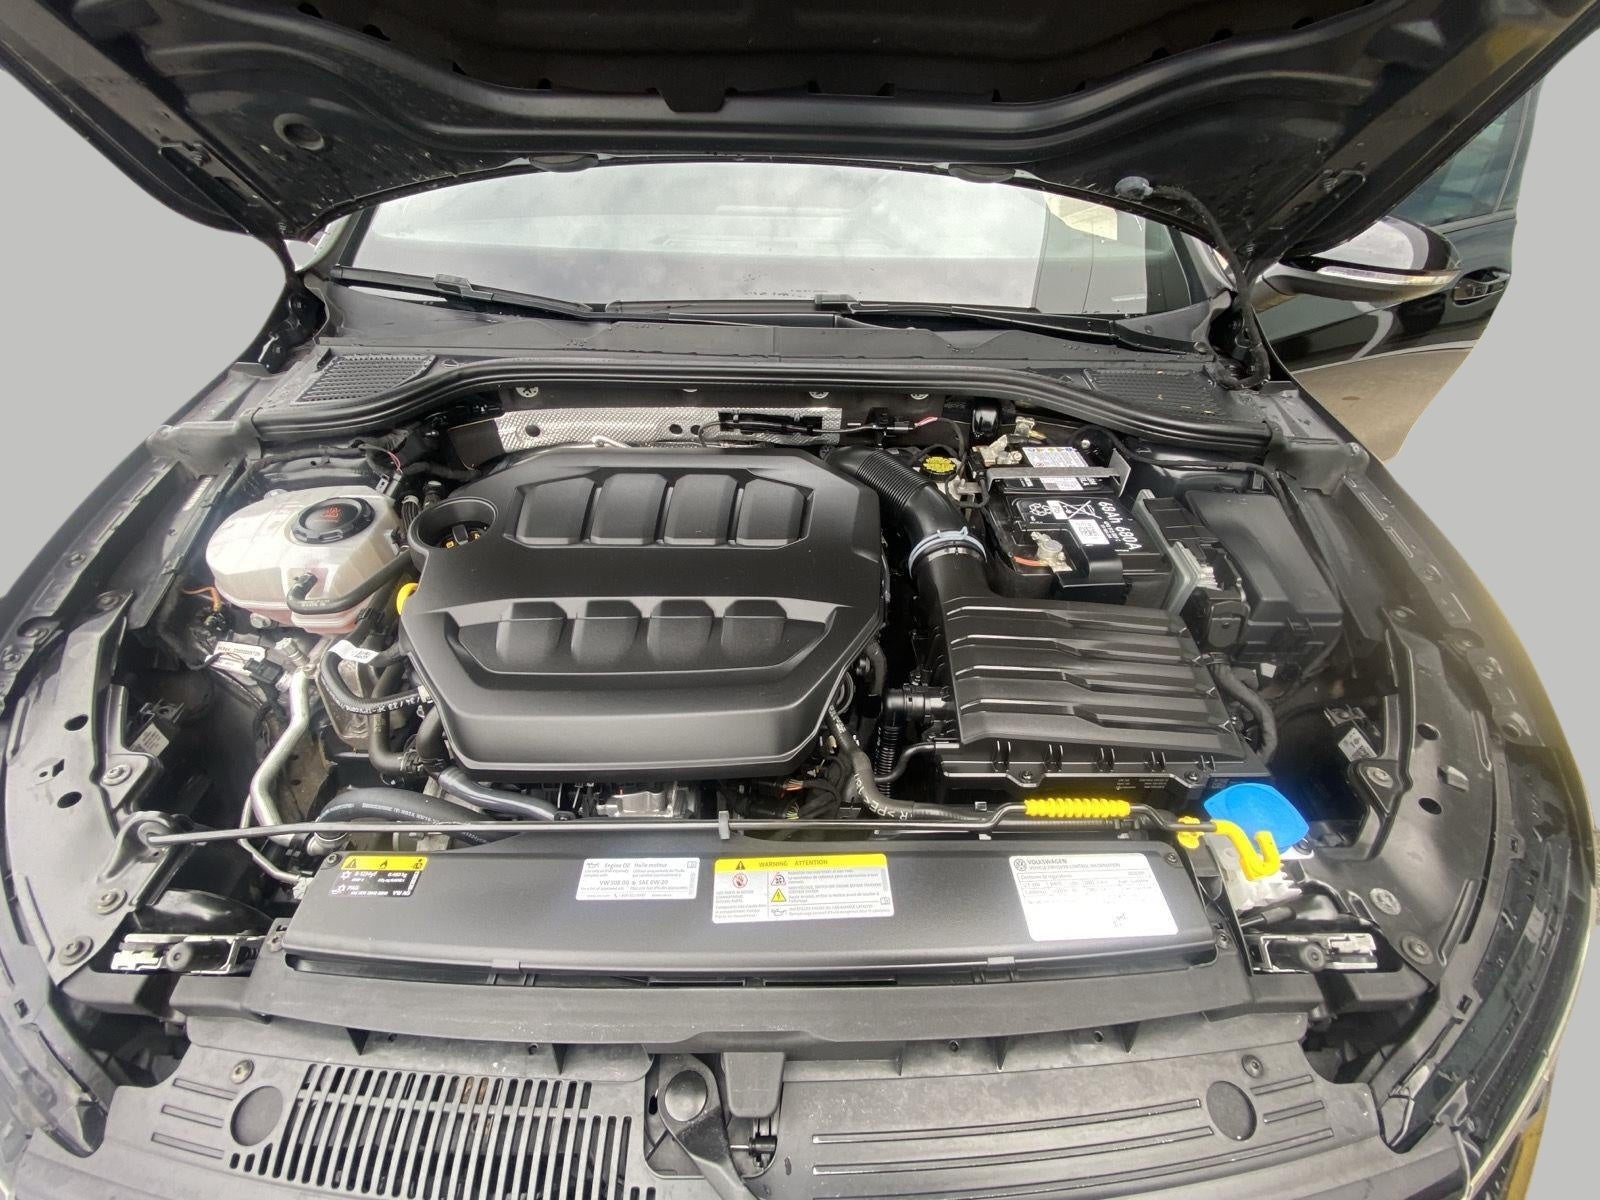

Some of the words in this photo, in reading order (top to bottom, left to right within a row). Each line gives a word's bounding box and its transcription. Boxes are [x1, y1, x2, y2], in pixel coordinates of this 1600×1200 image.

[1098, 501, 1123, 523] 68Ah
[1115, 527, 1142, 550] 680A
[758, 860, 788, 868] WARNING
[794, 859, 828, 867] ATTENTION
